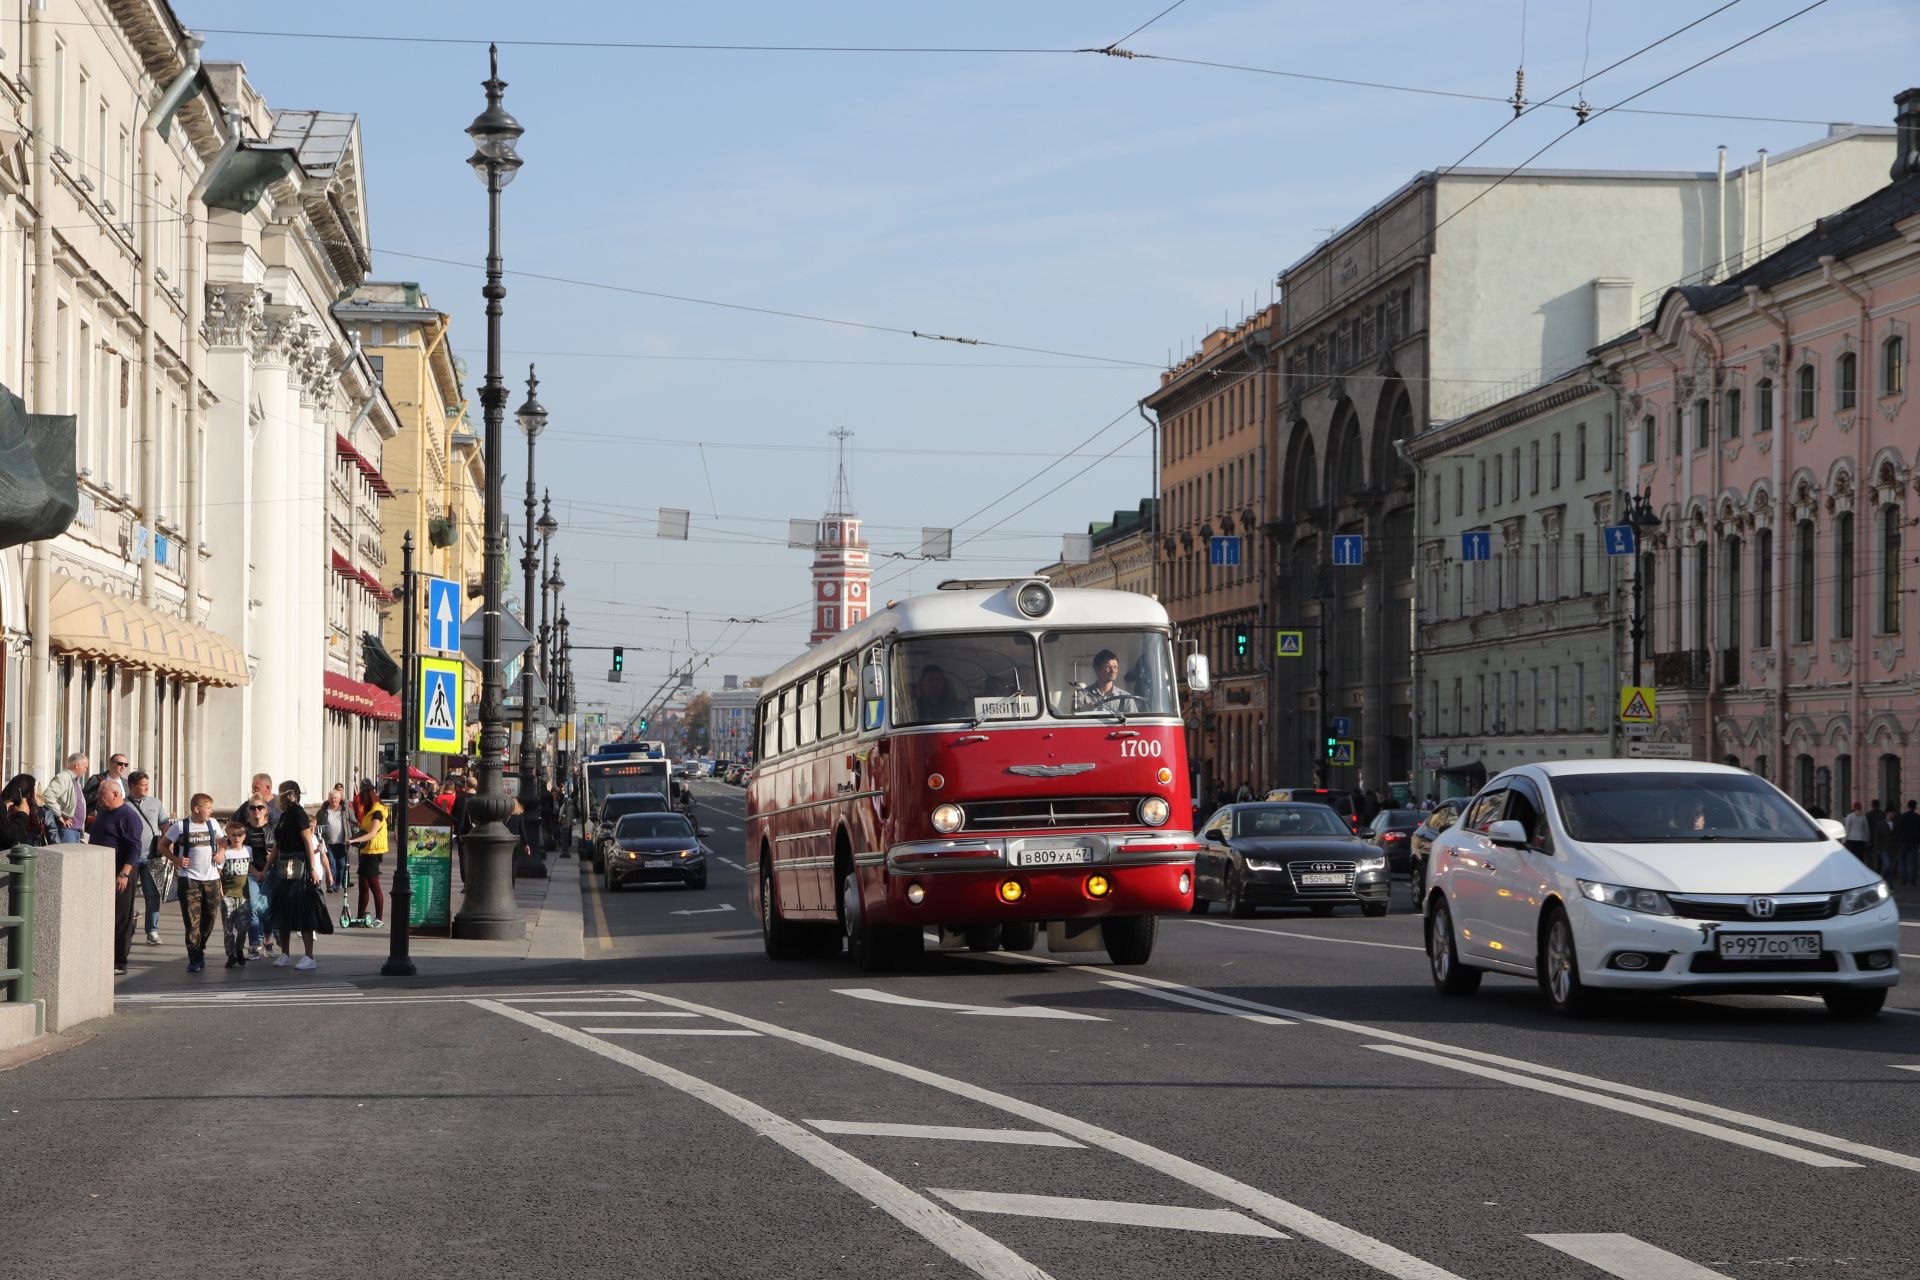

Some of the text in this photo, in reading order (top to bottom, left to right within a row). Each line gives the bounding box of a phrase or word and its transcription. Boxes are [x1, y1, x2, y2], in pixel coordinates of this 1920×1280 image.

[1121, 739, 1162, 758] 1700
[1075, 848, 1088, 859] 47
[1792, 936, 1814, 949] 178
